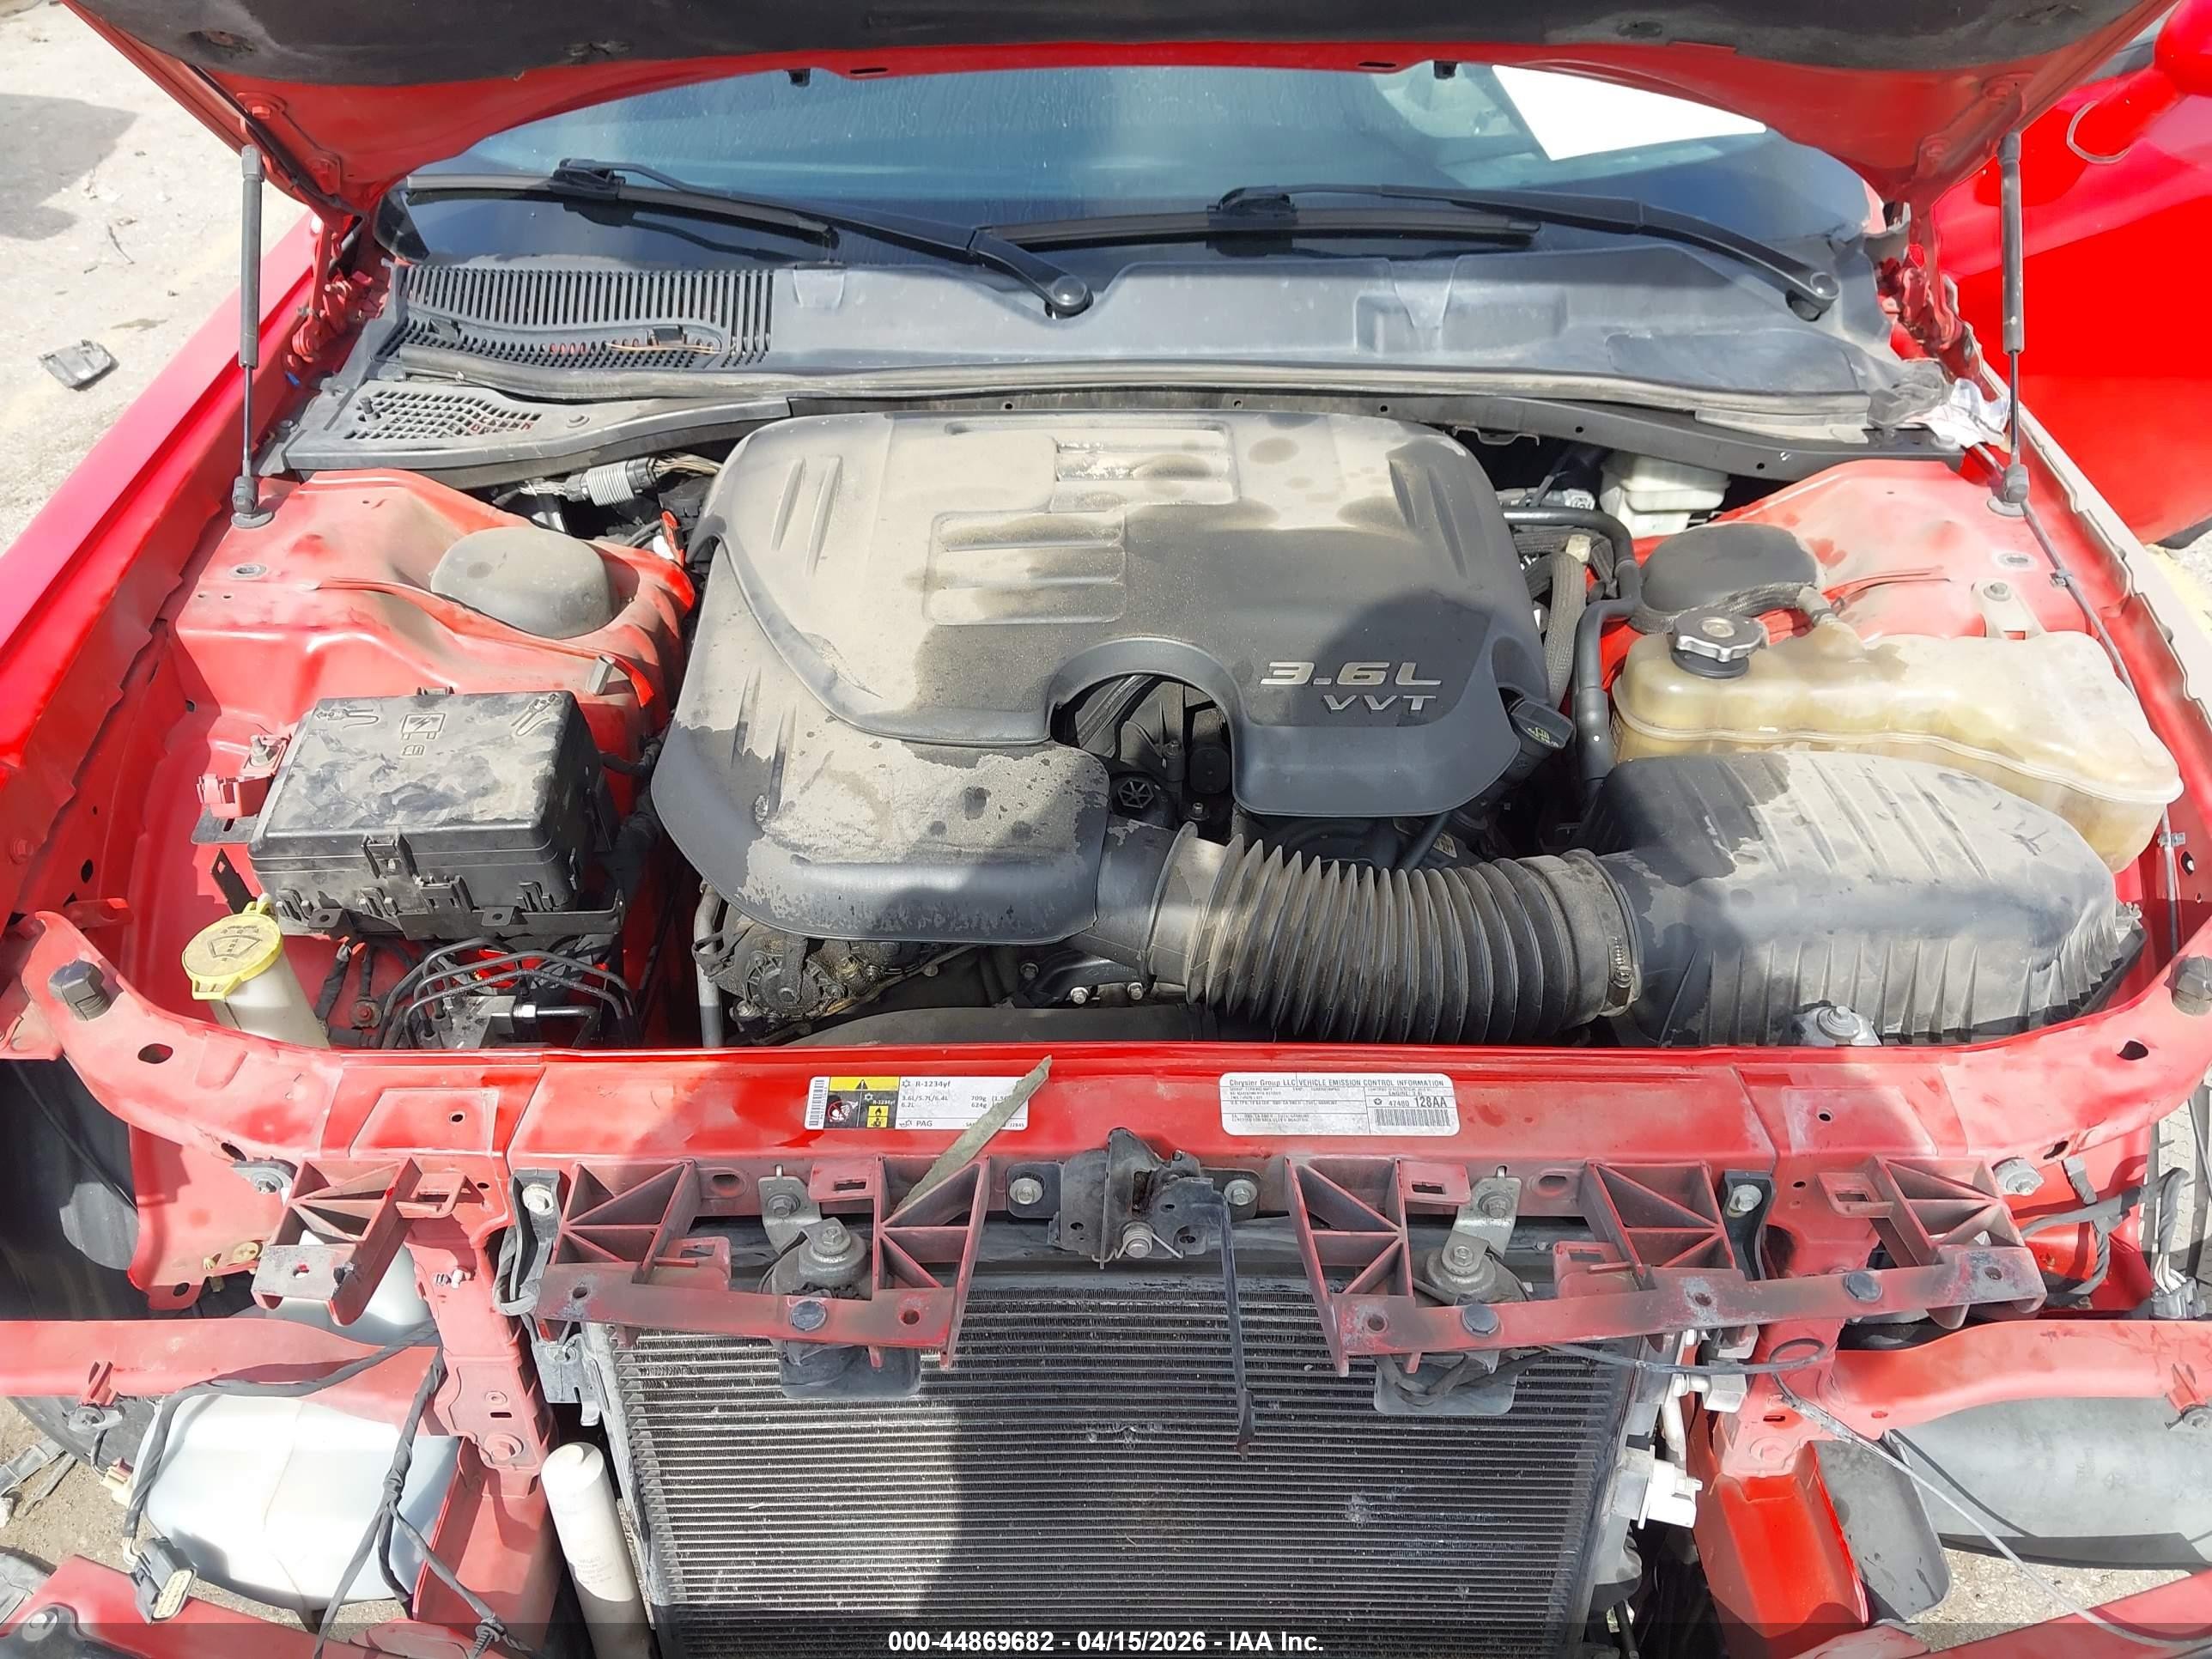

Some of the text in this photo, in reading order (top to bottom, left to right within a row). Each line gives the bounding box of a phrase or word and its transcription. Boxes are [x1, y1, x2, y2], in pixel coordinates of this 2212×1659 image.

[1260, 660, 1442, 686] 3.6L
[1322, 694, 1437, 712] VVT
[915, 1079, 951, 1089] R-1234yf
[1229, 1079, 1259, 1088] Chrysler
[1260, 1079, 1281, 1088] Group
[1415, 1097, 1448, 1108] 128AA
